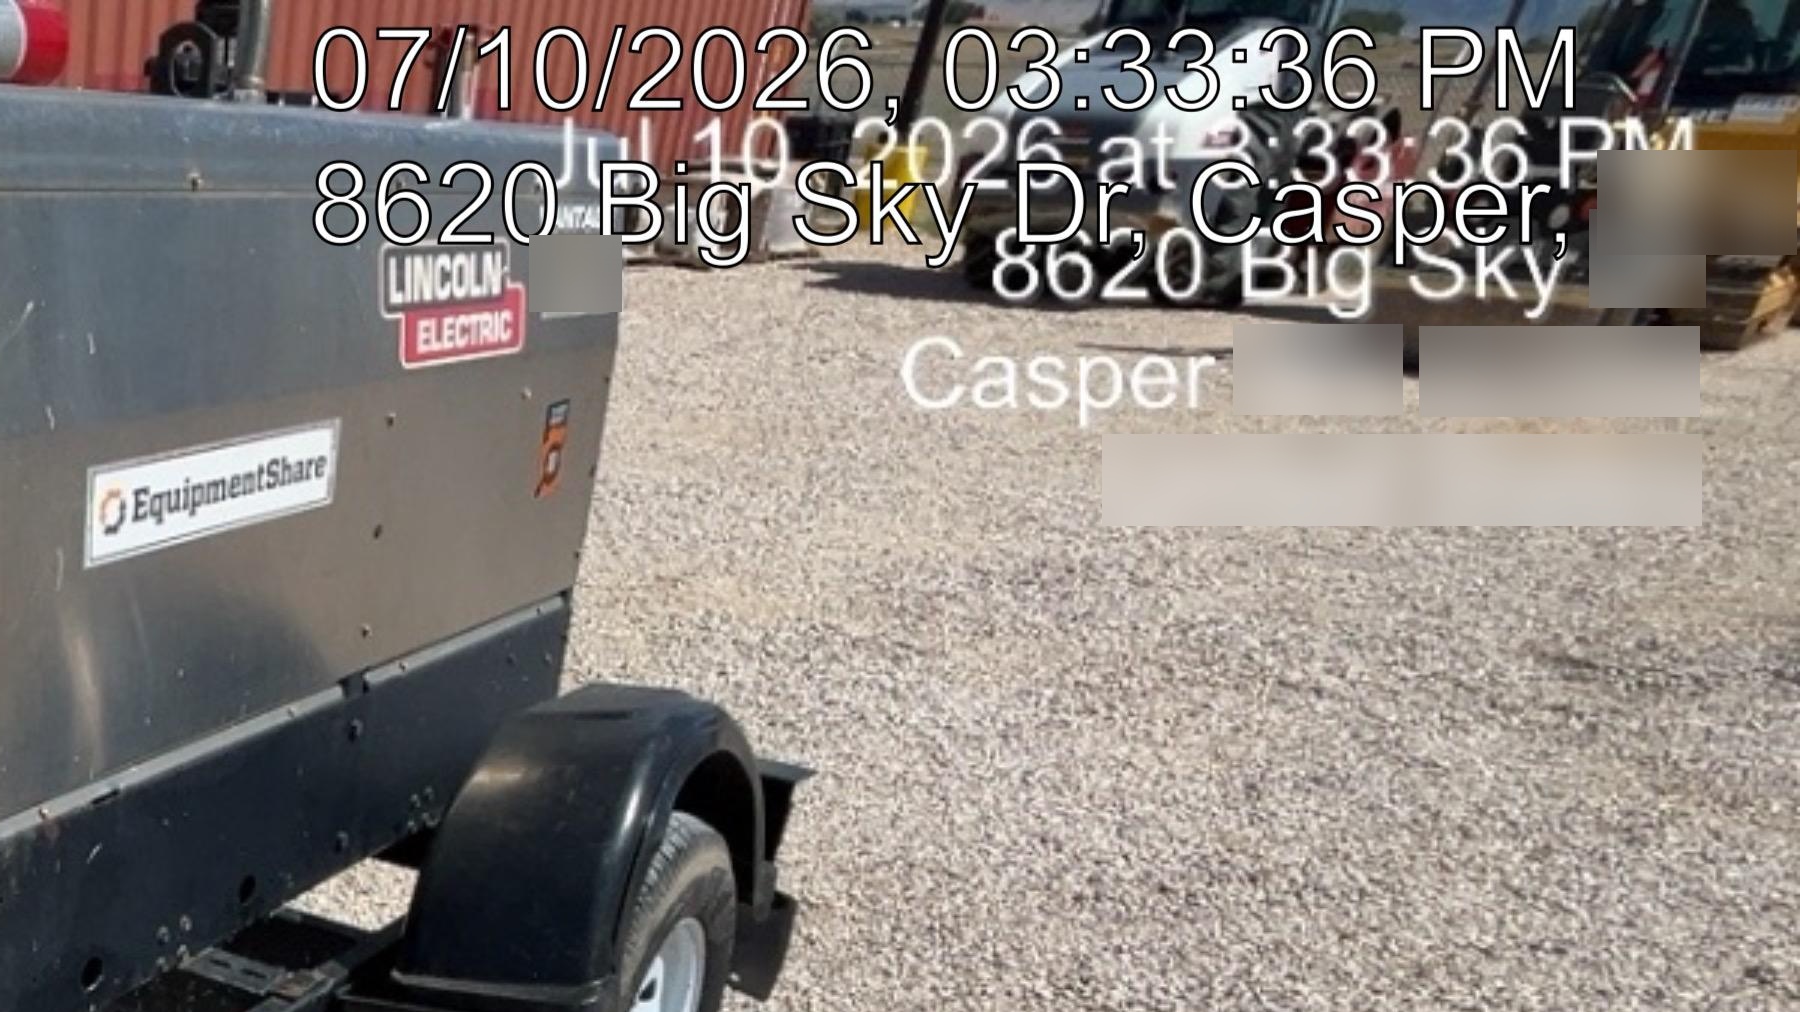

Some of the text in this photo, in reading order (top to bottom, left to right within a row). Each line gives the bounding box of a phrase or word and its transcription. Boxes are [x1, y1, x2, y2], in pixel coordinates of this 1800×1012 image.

[388, 251, 505, 305] LINCOLN
[415, 309, 514, 355] ELECTRIC
[131, 455, 328, 525] EquipmentShare
